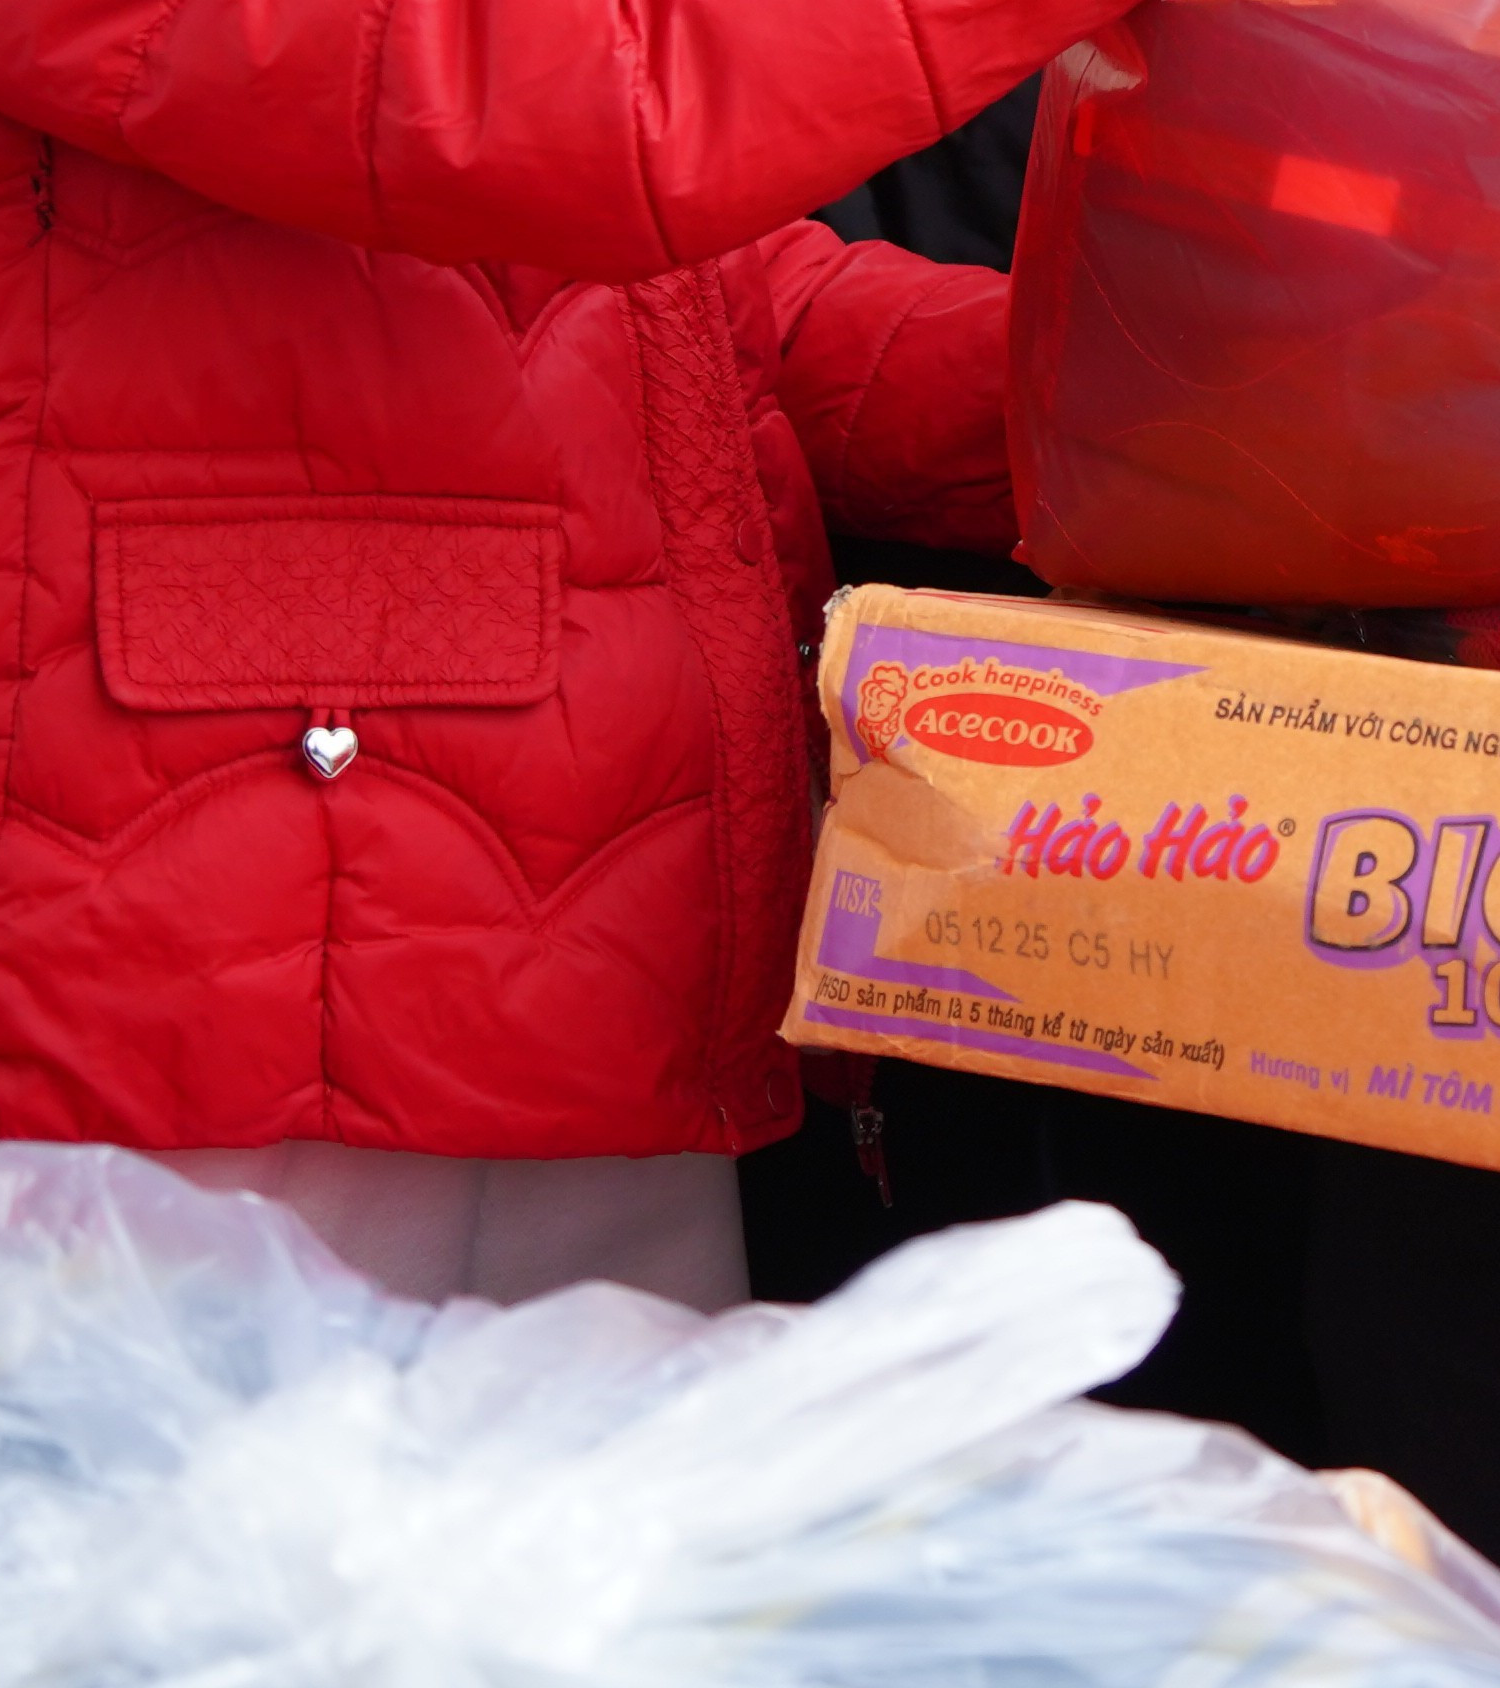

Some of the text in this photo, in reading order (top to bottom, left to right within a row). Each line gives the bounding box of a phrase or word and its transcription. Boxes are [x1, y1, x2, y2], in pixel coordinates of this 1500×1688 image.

[913, 662, 1104, 717] Cook happiness
[1214, 692, 1265, 724] SẢN
[1268, 699, 1336, 734] PHẨM
[1344, 712, 1383, 740] VỚI
[1388, 717, 1457, 750] CÔNG
[999, 792, 1281, 884] Hảo Hảo
[924, 910, 1175, 980] 05 12 25 C5 HY
[856, 983, 886, 1009] sản
[893, 988, 941, 1018] phẩm
[948, 997, 963, 1020] là
[969, 1003, 981, 1023] 5
[988, 1006, 1035, 1038] tháng
[1041, 1012, 1066, 1037] kể
[1070, 1018, 1088, 1043] từ
[1094, 1024, 1137, 1056] ngày
[1141, 1030, 1175, 1059] sản
[1180, 1038, 1226, 1070] xuất)
[1249, 1050, 1320, 1090] Hương
[1367, 1062, 1416, 1102] MÌ
[1421, 1070, 1495, 1114] TÔM
